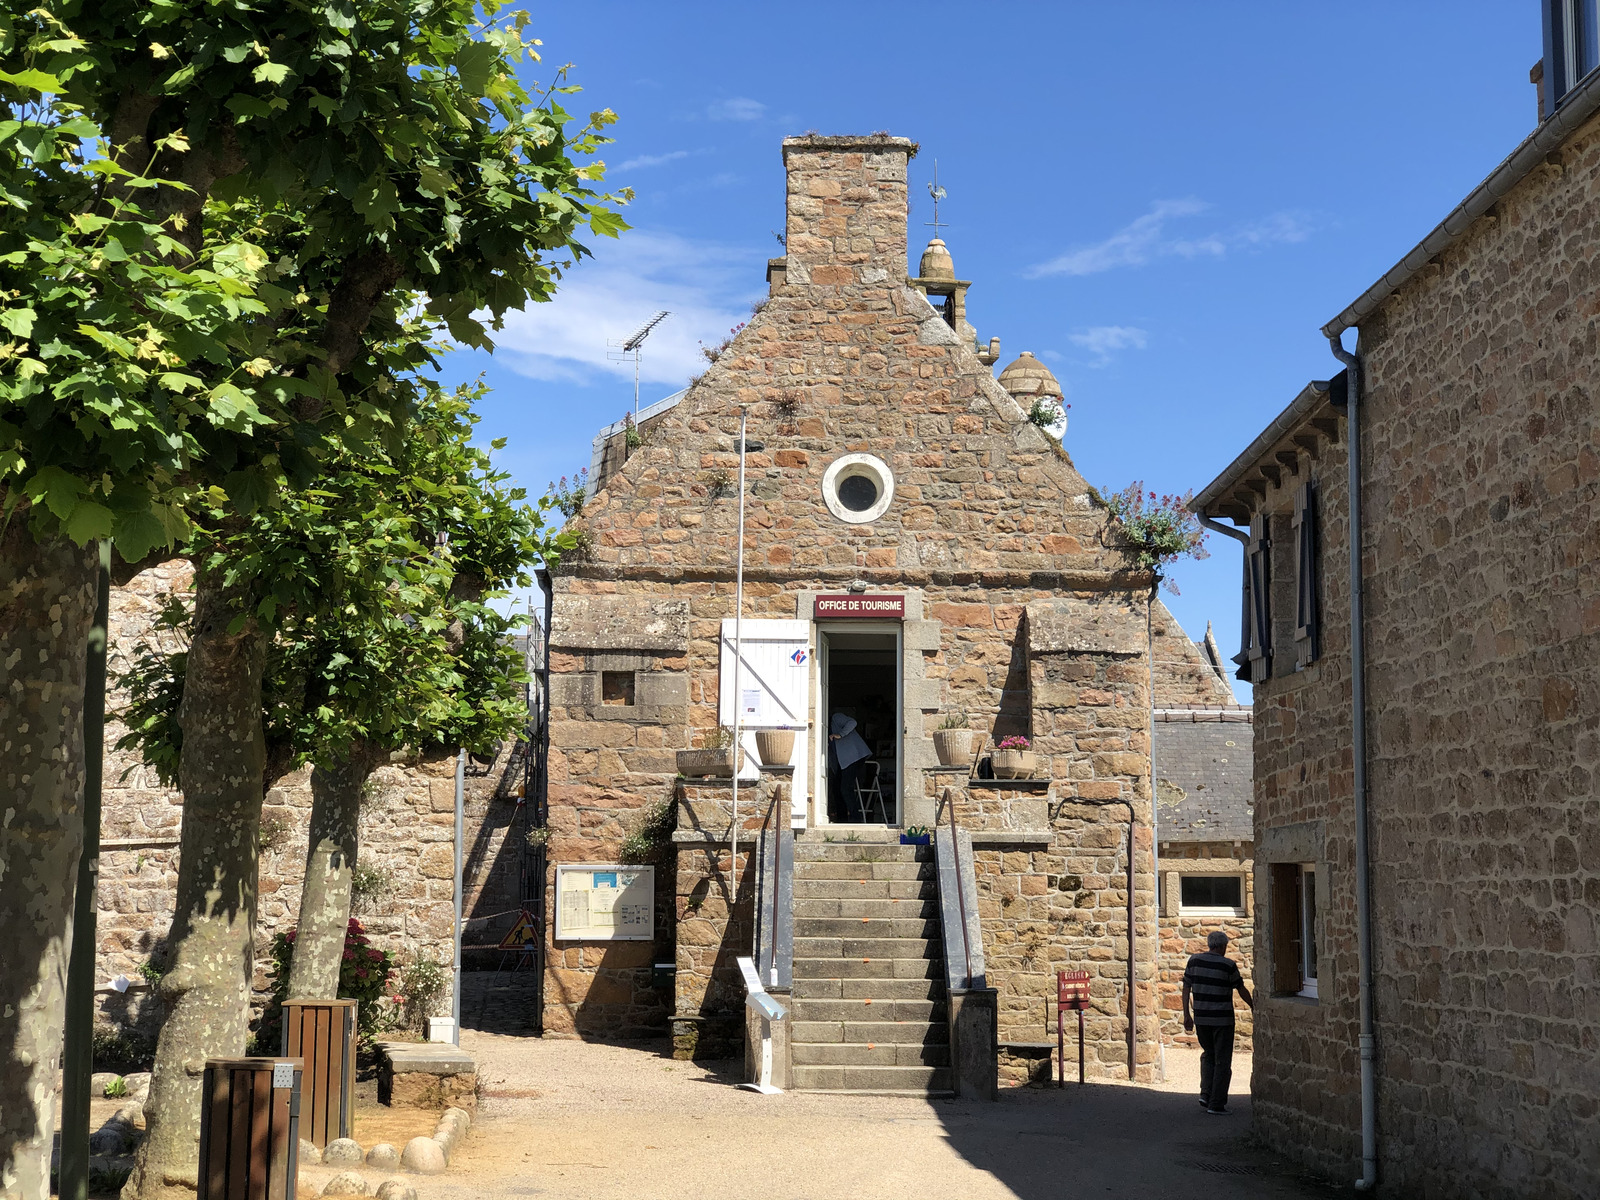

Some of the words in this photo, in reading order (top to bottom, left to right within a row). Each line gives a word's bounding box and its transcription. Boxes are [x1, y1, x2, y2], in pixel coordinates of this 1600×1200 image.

[819, 600, 847, 610] OFFICE
[848, 600, 860, 610] DE
[861, 600, 902, 610] TOURISME
